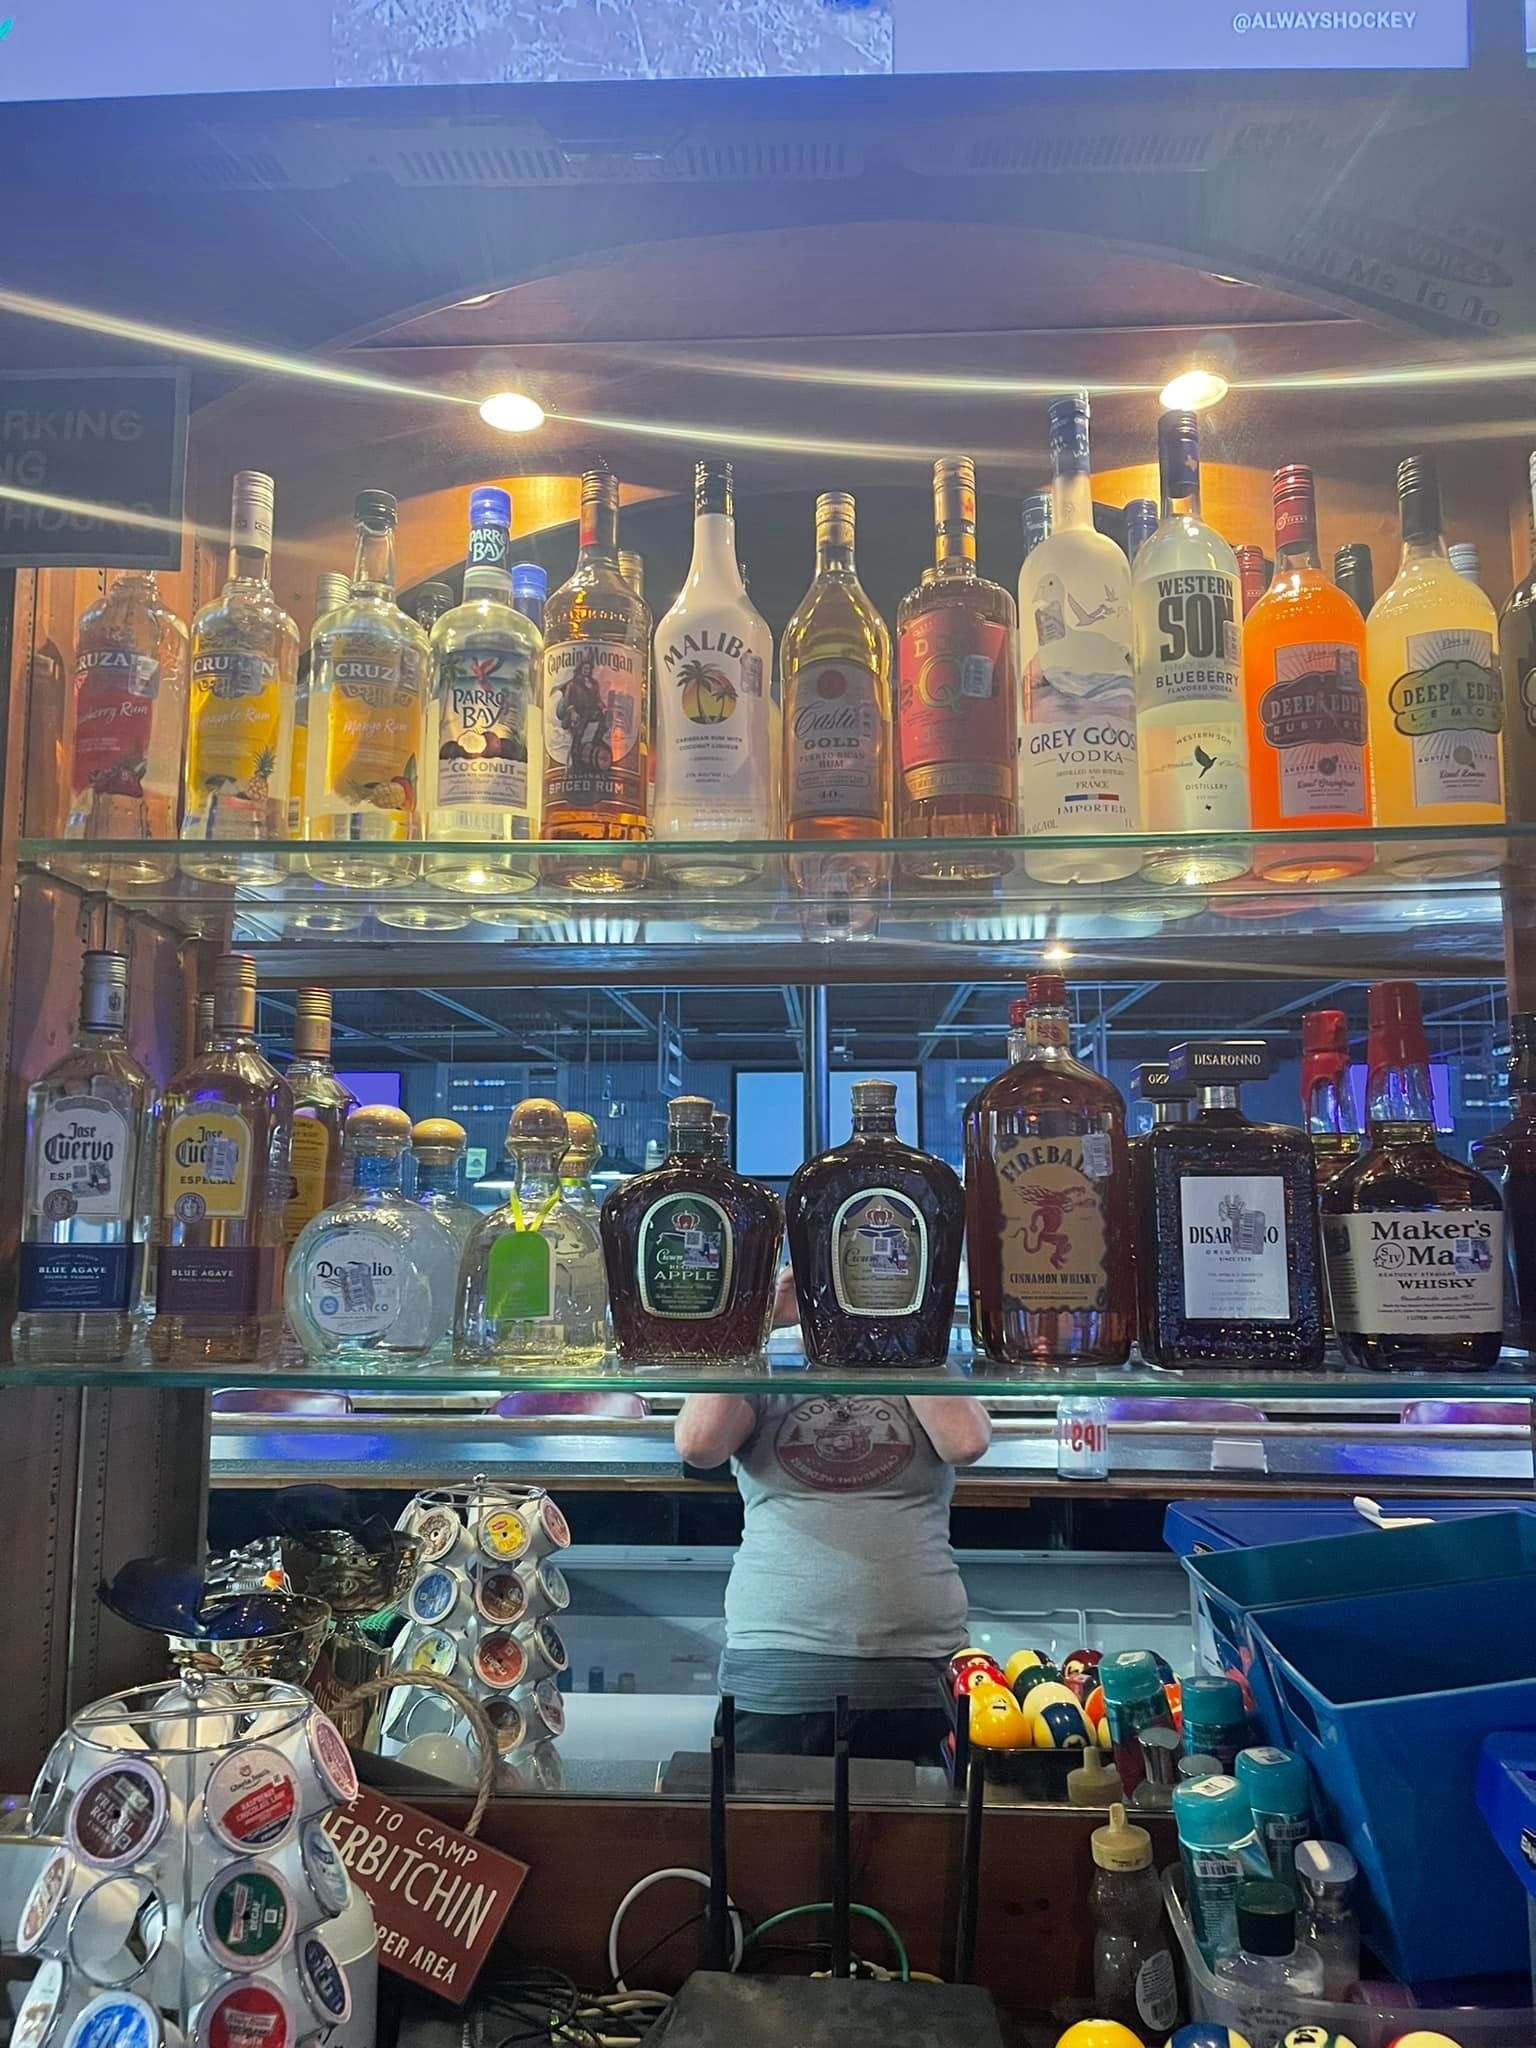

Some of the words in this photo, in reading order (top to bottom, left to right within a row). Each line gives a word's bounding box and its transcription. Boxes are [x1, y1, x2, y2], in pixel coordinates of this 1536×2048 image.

[1233, 11, 1416, 33] @ALWAYSHOCKEY
[472, 542, 506, 563] BAY
[1158, 576, 1234, 598] WESTERN
[1158, 594, 1234, 663] SON
[663, 630, 753, 672] MALIB
[193, 656, 275, 677] CRUN
[548, 651, 583, 676] Captain
[586, 646, 633, 674] Morgan
[1156, 671, 1239, 688] BLUEBERRY
[1167, 684, 1208, 694] FLAVORED
[453, 688, 506, 713] PARRO
[1403, 683, 1449, 707] DEEP
[1271, 695, 1314, 719] DEEP
[1329, 693, 1366, 713] EDD
[463, 705, 502, 729] BAY
[1274, 720, 1322, 736] RUBY
[804, 738, 860, 751] GOLD
[1031, 728, 1077, 755] GREY
[1175, 732, 1214, 745] WESTERN
[1216, 734, 1232, 745] SON
[819, 760, 844, 769] RUM
[1058, 750, 1124, 764] VODKA
[452, 761, 515, 774] COCONUT
[549, 781, 591, 795] SPICED
[596, 781, 624, 794] RUM
[1076, 781, 1109, 790] FRANCE
[1058, 804, 1126, 815] IMPORTED
[1194, 1054, 1261, 1065] DISARONNO
[68, 1122, 97, 1140] Jose
[44, 1133, 113, 1164] Cuervo
[1371, 1219, 1491, 1240] Maker's
[1407, 1246, 1456, 1266] Ma
[39, 1266, 67, 1274] BLUE
[71, 1266, 107, 1274] AGAVE
[171, 1269, 198, 1277] BLUE
[201, 1269, 234, 1277] AGAVE
[317, 1261, 343, 1278] Do
[654, 1271, 720, 1281] APPLE
[1010, 1273, 1058, 1284] CINNAMON
[1060, 1273, 1098, 1284] WHISKY
[1397, 1279, 1477, 1289] WHISKY
[375, 1805, 404, 1832] TO
[416, 1828, 478, 1867] CAMP
[320, 1811, 497, 1950] ERBITCHIN
[249, 1901, 261, 1930] DECAF
[374, 1922, 410, 1960] PER
[409, 1946, 458, 1985] AREA
